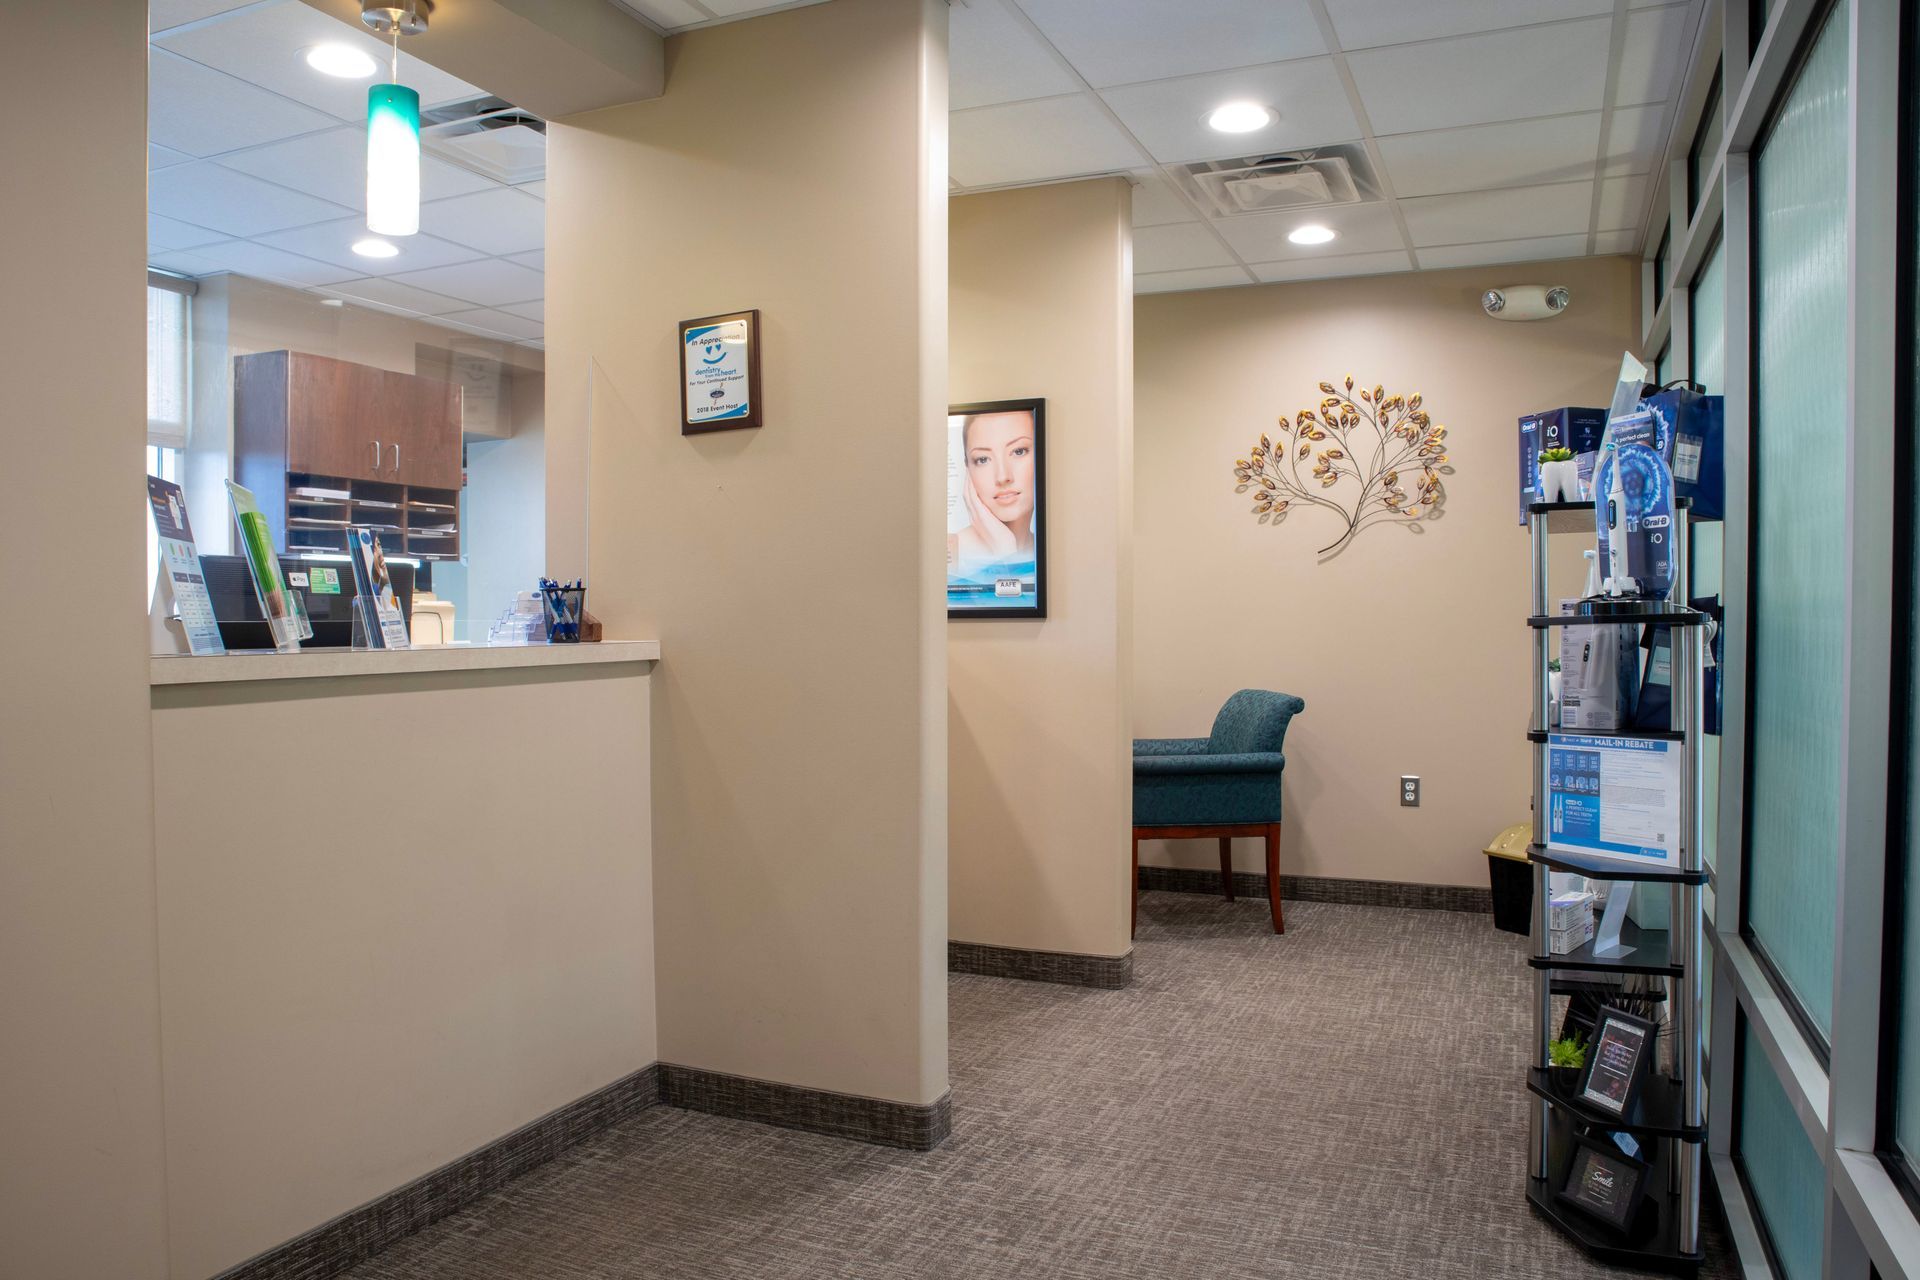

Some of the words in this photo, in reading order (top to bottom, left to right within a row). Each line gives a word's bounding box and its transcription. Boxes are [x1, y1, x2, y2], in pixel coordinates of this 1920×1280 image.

[695, 367, 720, 375] dentistry
[1619, 434, 1636, 443] perfect
[1644, 517, 1667, 527] Oral-B
[1594, 739, 1624, 747] MAIL-IN
[1625, 740, 1654, 749] REBATE
[1591, 1171, 1614, 1188] Smile
